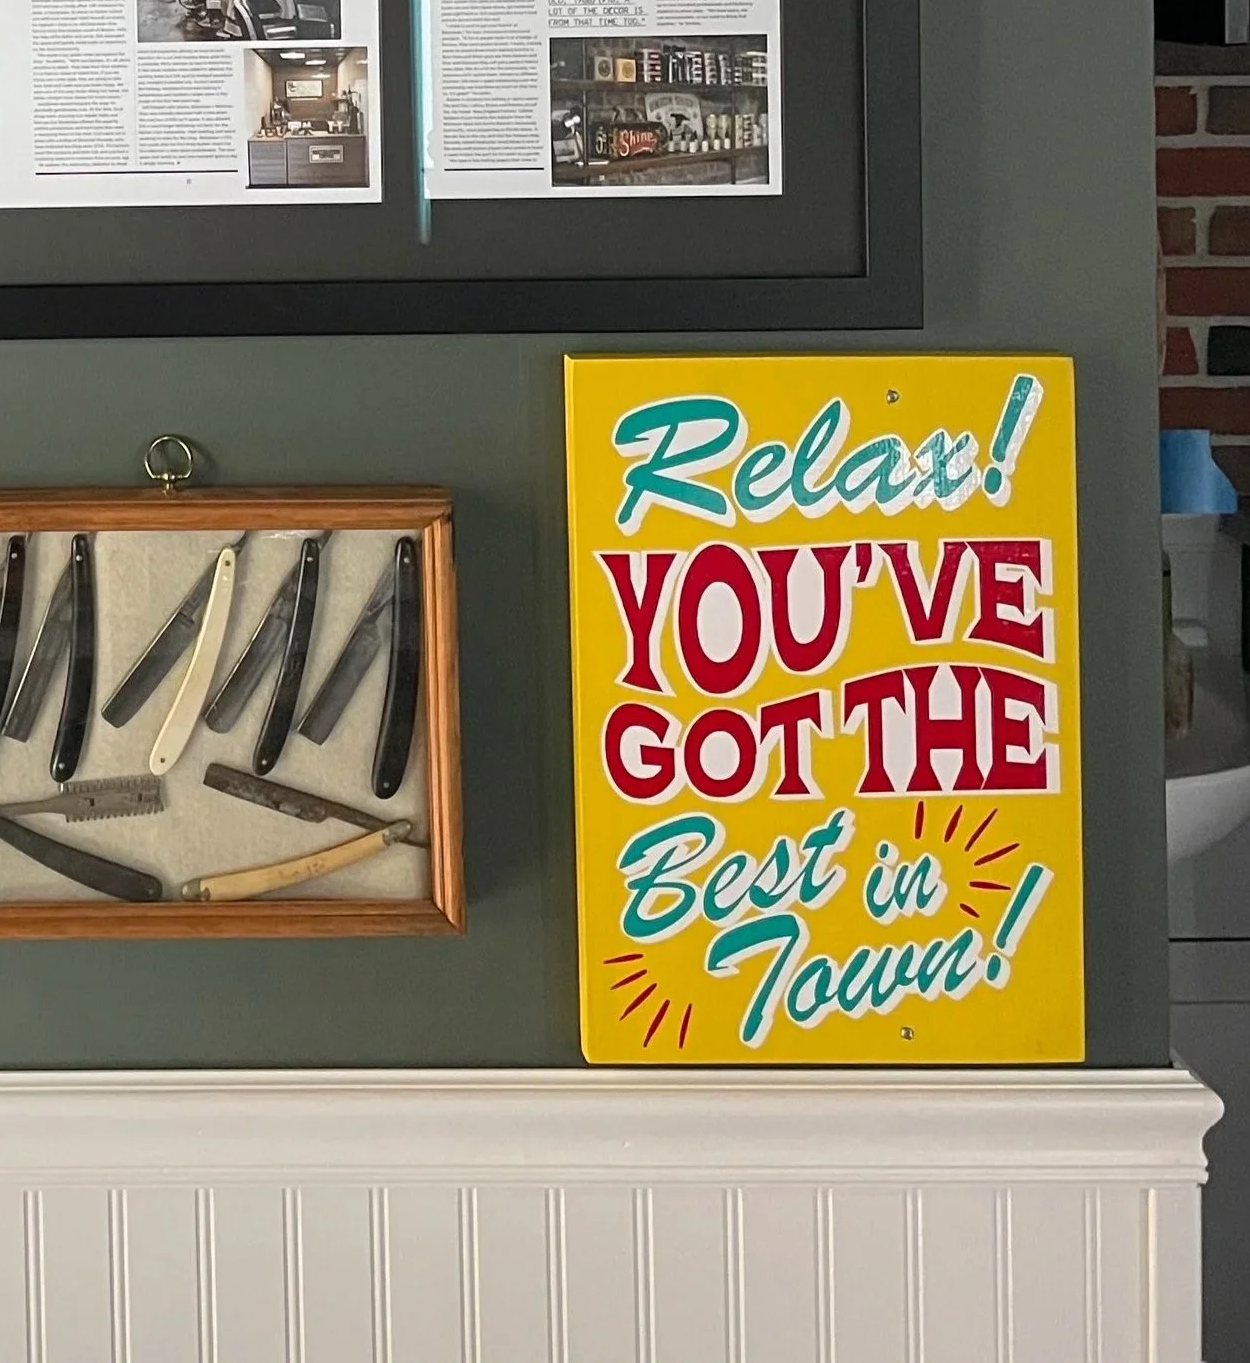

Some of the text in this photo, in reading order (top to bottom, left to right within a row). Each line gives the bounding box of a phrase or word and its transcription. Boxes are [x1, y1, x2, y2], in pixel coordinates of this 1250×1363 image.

[619, 130, 654, 157] Shine
[613, 374, 1043, 534] Relax!
[594, 538, 1055, 696] YOU'VE
[602, 663, 1060, 803] GOT THE
[619, 807, 947, 943] Best in
[705, 862, 1053, 1048] Town!
